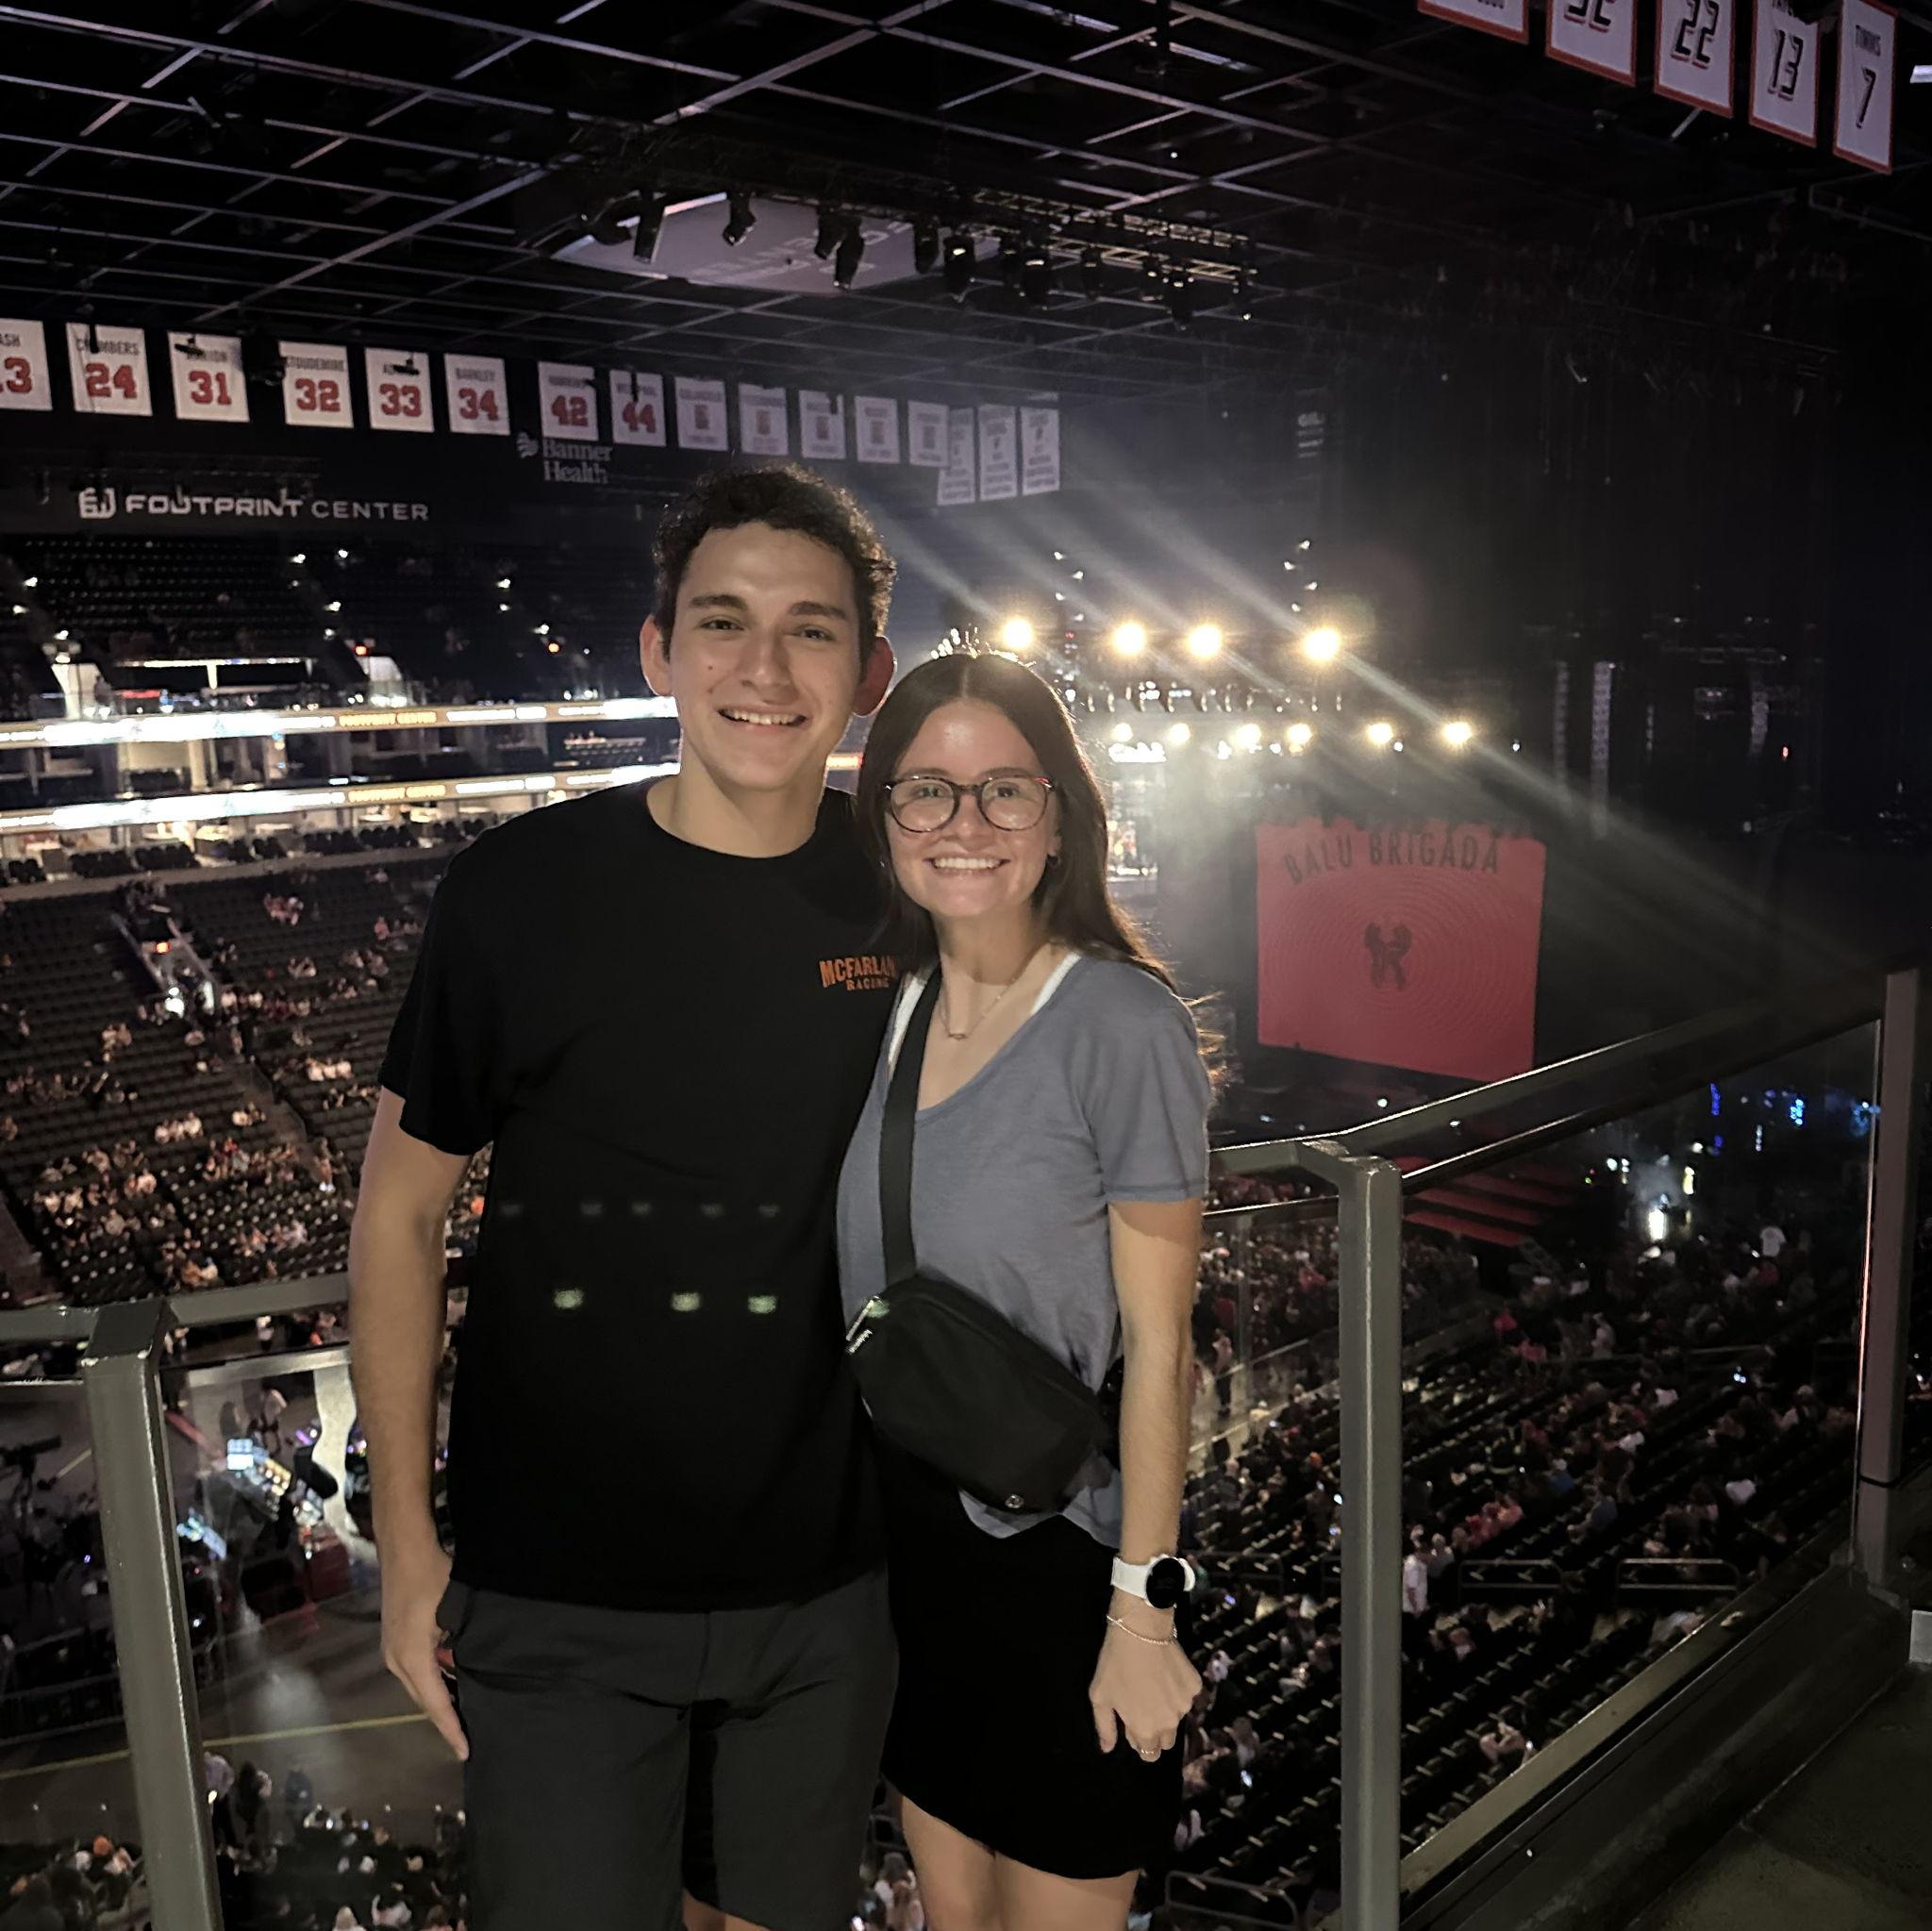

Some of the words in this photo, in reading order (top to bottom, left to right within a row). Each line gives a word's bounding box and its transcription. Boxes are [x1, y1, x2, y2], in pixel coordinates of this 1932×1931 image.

[1671, 0, 1719, 69] 22
[1768, 29, 1803, 101] 13
[1856, 67, 1876, 129] 7
[76, 339, 140, 356] CHMBERS
[0, 357, 32, 393] 3
[85, 362, 138, 399] 24
[189, 371, 232, 406] 31
[294, 378, 341, 412] 32
[379, 383, 423, 417] 33
[458, 387, 499, 421] 34
[551, 395, 589, 427] 42
[623, 402, 657, 434] 44
[541, 439, 612, 461] Banner
[543, 460, 608, 484] Health
[125, 494, 303, 517] FOOTPRINT
[311, 499, 429, 521] CENTER
[1369, 831, 1498, 874] BRIGADA
